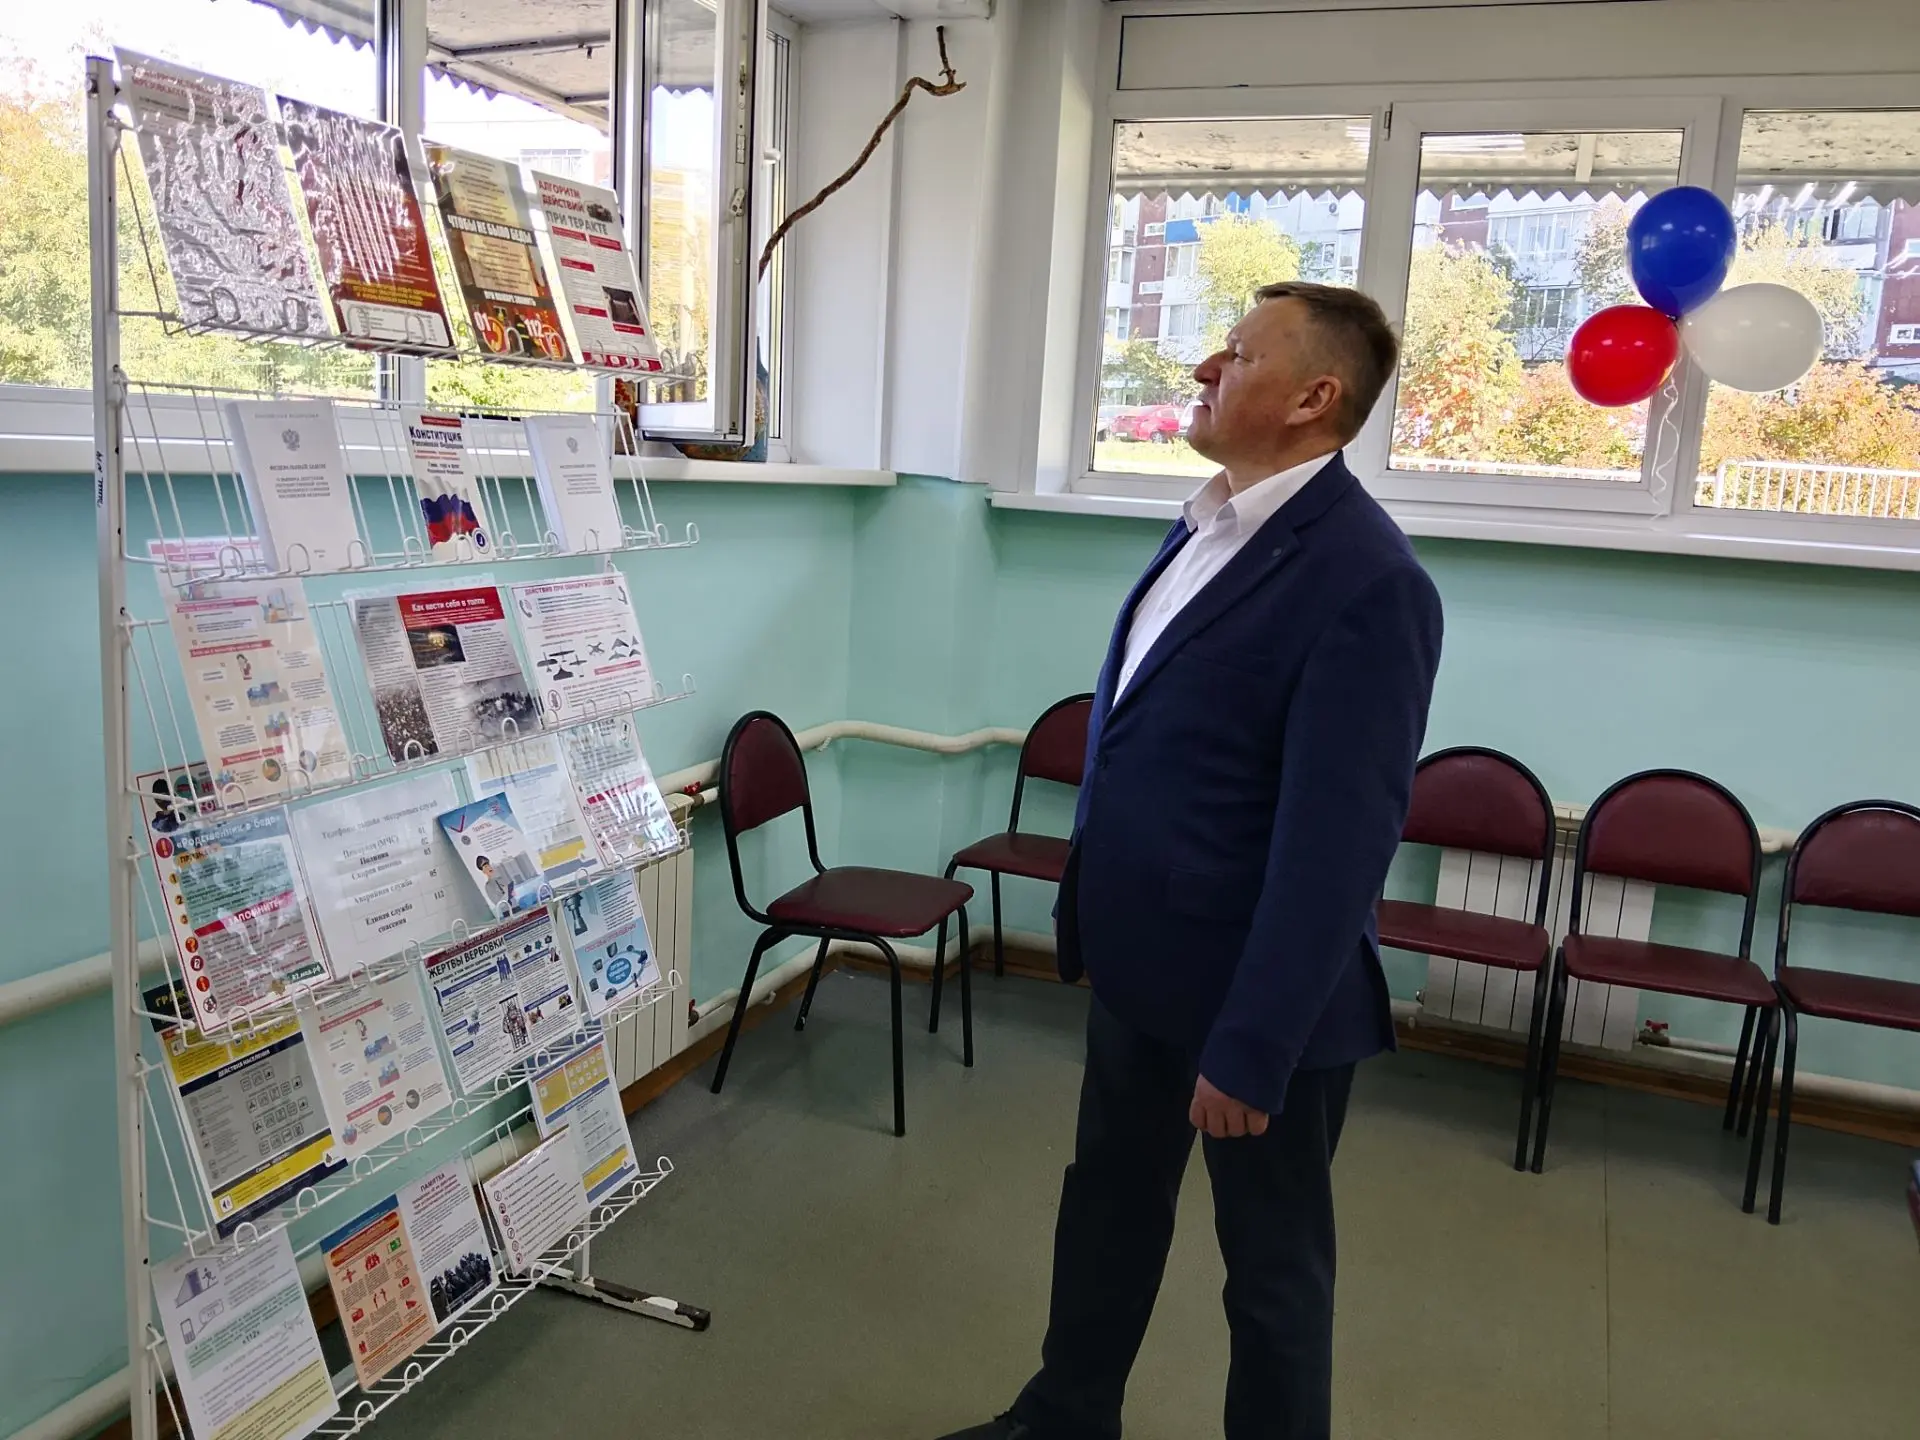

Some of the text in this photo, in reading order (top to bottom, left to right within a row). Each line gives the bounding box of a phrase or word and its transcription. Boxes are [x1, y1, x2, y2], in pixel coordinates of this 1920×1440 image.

[538, 180, 582, 198] АЛГОРИТМ
[545, 210, 609, 236] ПРИ ТЕРАКТЕ
[473, 311, 492, 332] 01
[412, 603, 425, 612] Как
[390, 903, 414, 918] служба
[427, 956, 465, 980] ЖЕРТВЫ
[463, 936, 505, 965] ВЕРБОВКИ
